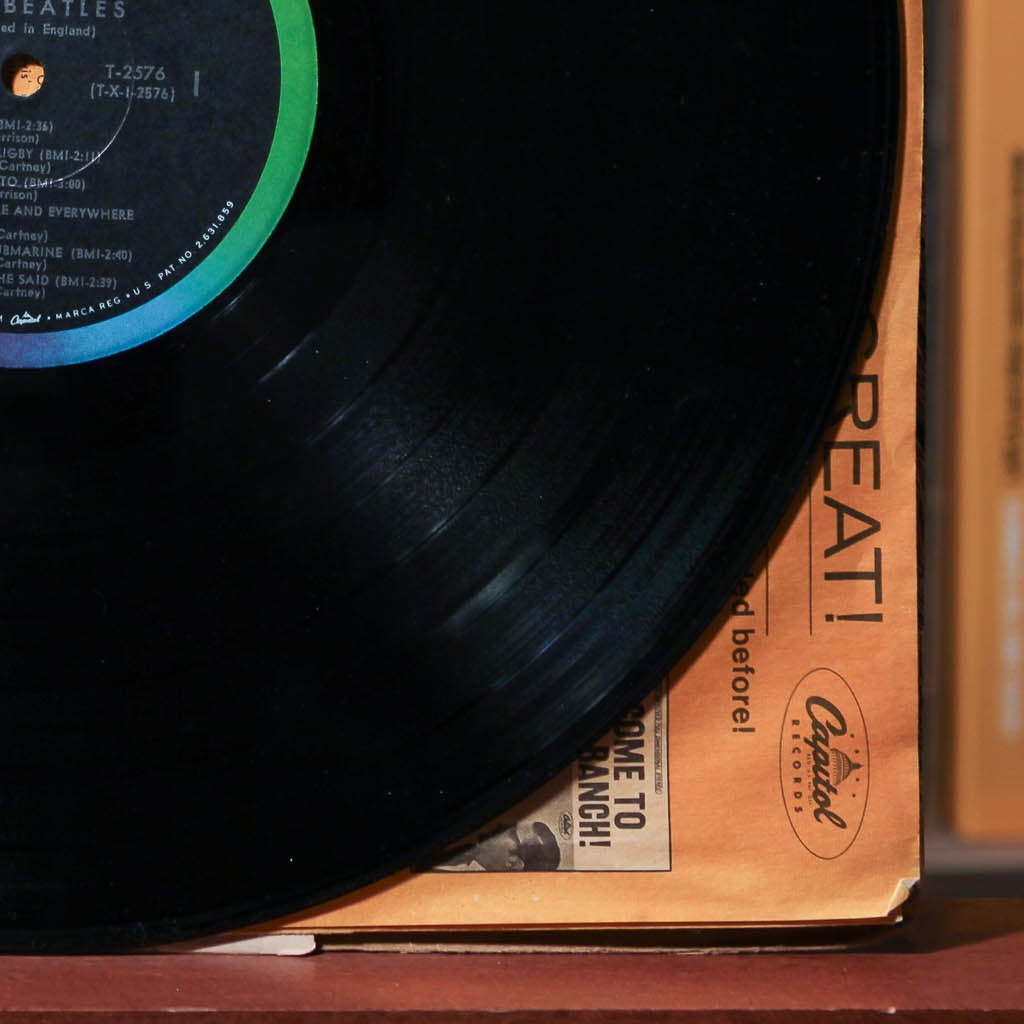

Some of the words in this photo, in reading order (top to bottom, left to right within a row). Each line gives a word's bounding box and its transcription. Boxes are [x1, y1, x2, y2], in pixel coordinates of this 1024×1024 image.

[24, 23, 35, 34] in
[42, 23, 96, 38] England)
[105, 64, 166, 81] T-2576
[0, 175, 16, 187] TO
[14, 205, 42, 217] AND
[48, 206, 135, 221] EVERYWHERE
[18, 272, 49, 285] SAID
[56, 306, 95, 320] MARCA
[99, 296, 121, 310] REG
[158, 264, 177, 280] PAT
[178, 251, 193, 264] NO
[824, 317, 883, 622] REAT!
[731, 629, 755, 733] before!
[792, 719, 803, 813] RECORDS
[804, 695, 847, 829] Capitol
[614, 792, 646, 830] TO
